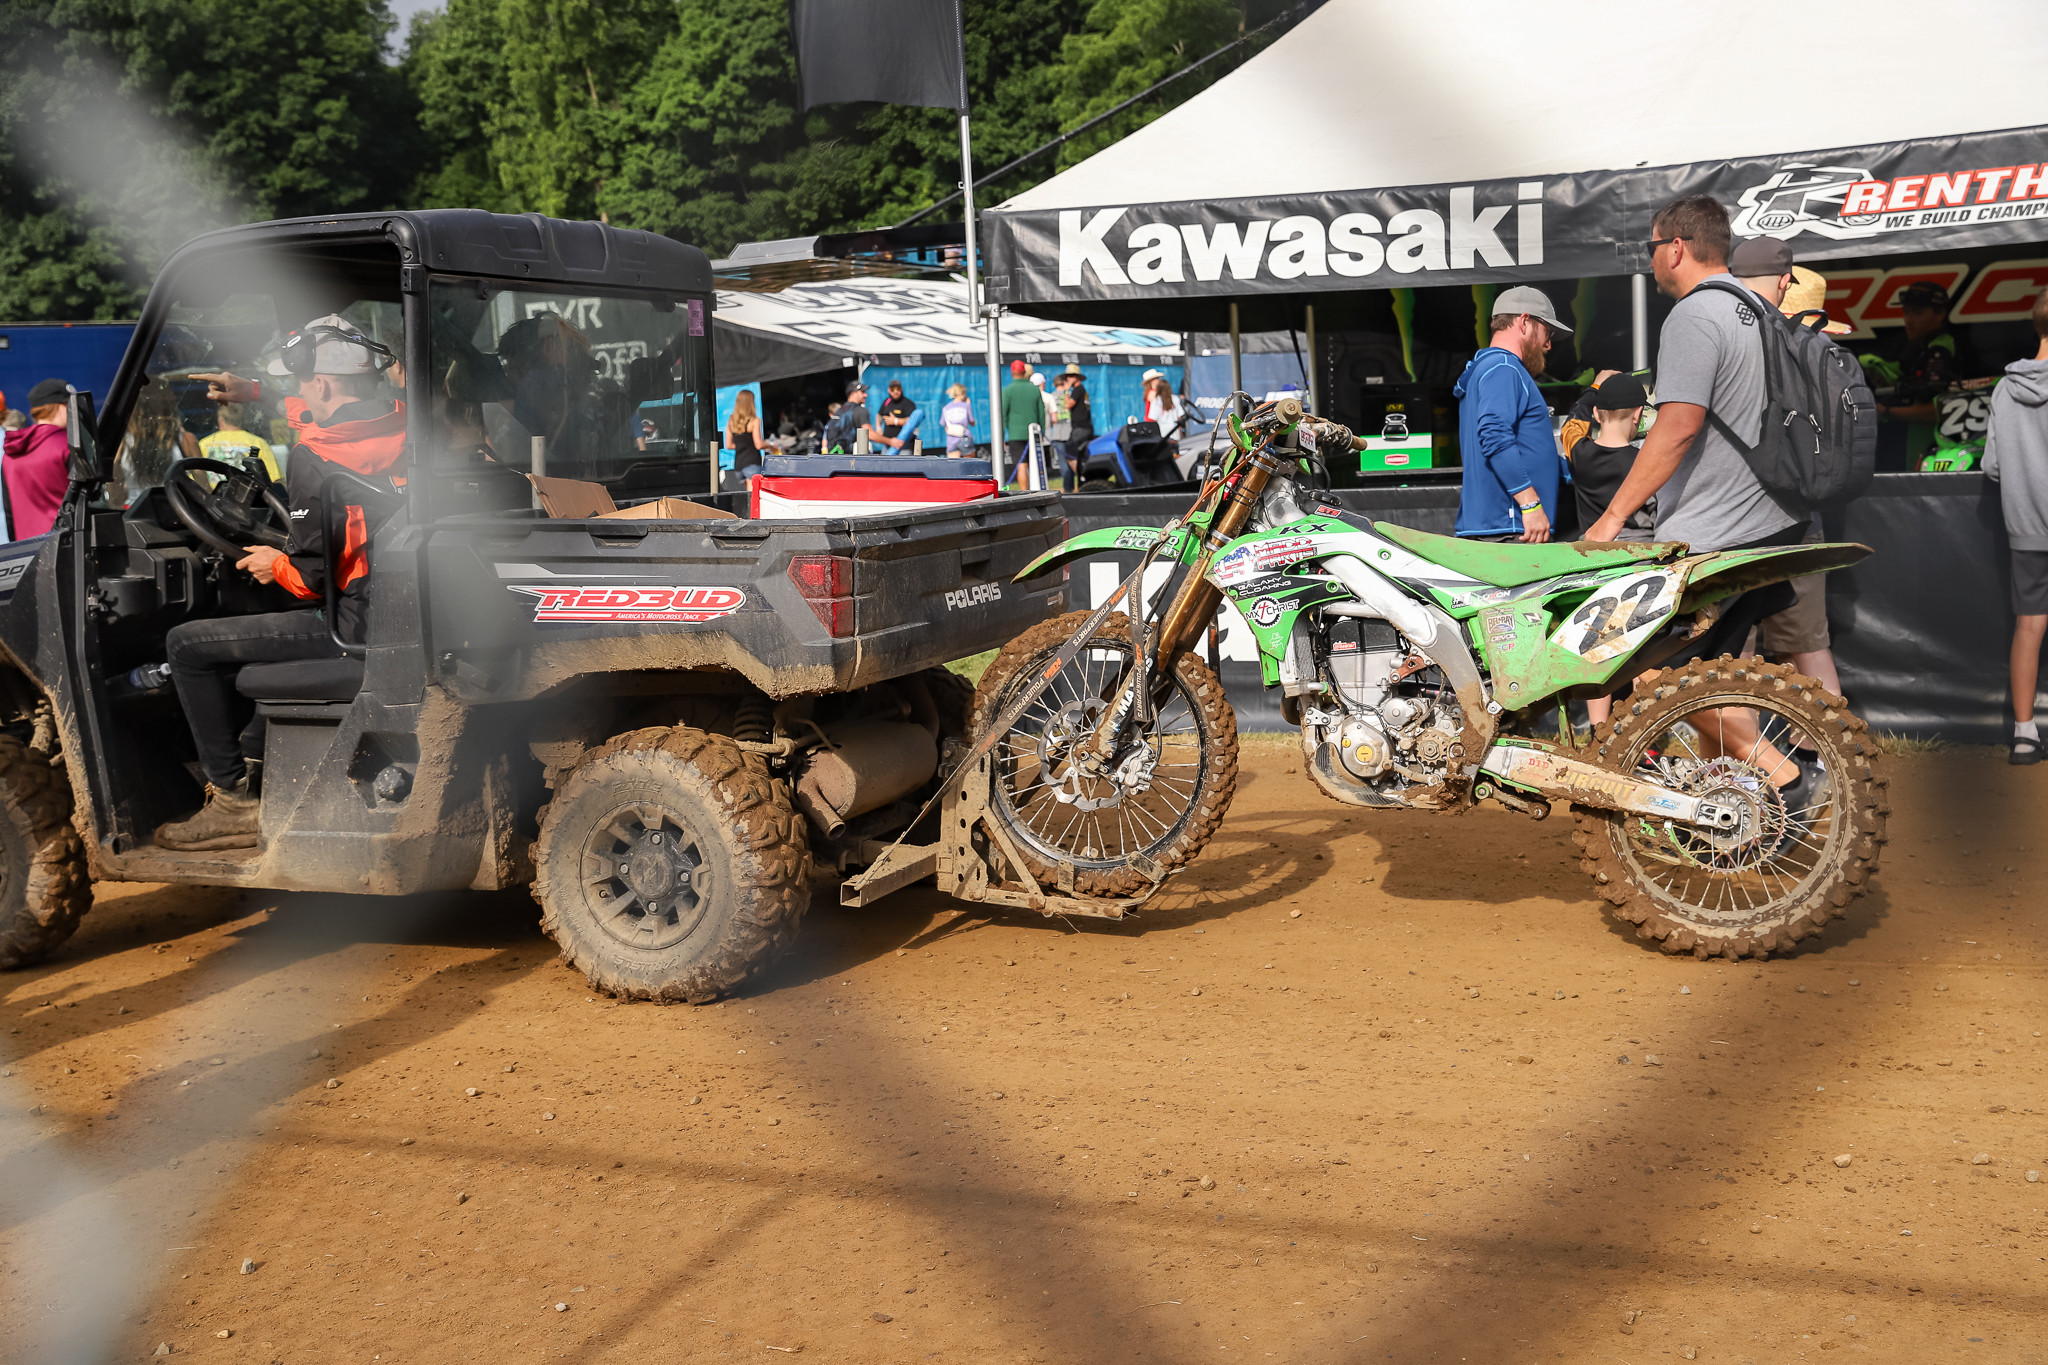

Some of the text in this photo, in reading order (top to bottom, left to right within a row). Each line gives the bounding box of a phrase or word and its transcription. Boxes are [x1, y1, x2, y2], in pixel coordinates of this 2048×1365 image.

[1885, 215, 1913, 229] WE
[1920, 209, 1971, 226] BUILD
[1058, 181, 1544, 287] Kawasaki
[1278, 522, 1332, 536] KX
[1238, 576, 1282, 591] GALAXY
[1239, 580, 1292, 597] CLOAKING
[1477, 589, 1511, 602] LUXON
[532, 588, 744, 608] REDBUD
[945, 582, 1002, 611] POLARIS
[616, 612, 700, 620] AMERICA'S MOTOCROSS TRACK
[1072, 603, 1110, 647] POWERPARTS
[1573, 575, 1672, 656] 22
[1130, 576, 1139, 626] POWERPARTS
[1136, 668, 1144, 719] POWERPARTS
[1006, 676, 1045, 721] POWERPARTS
[1557, 770, 1636, 799] CIRCUIT
